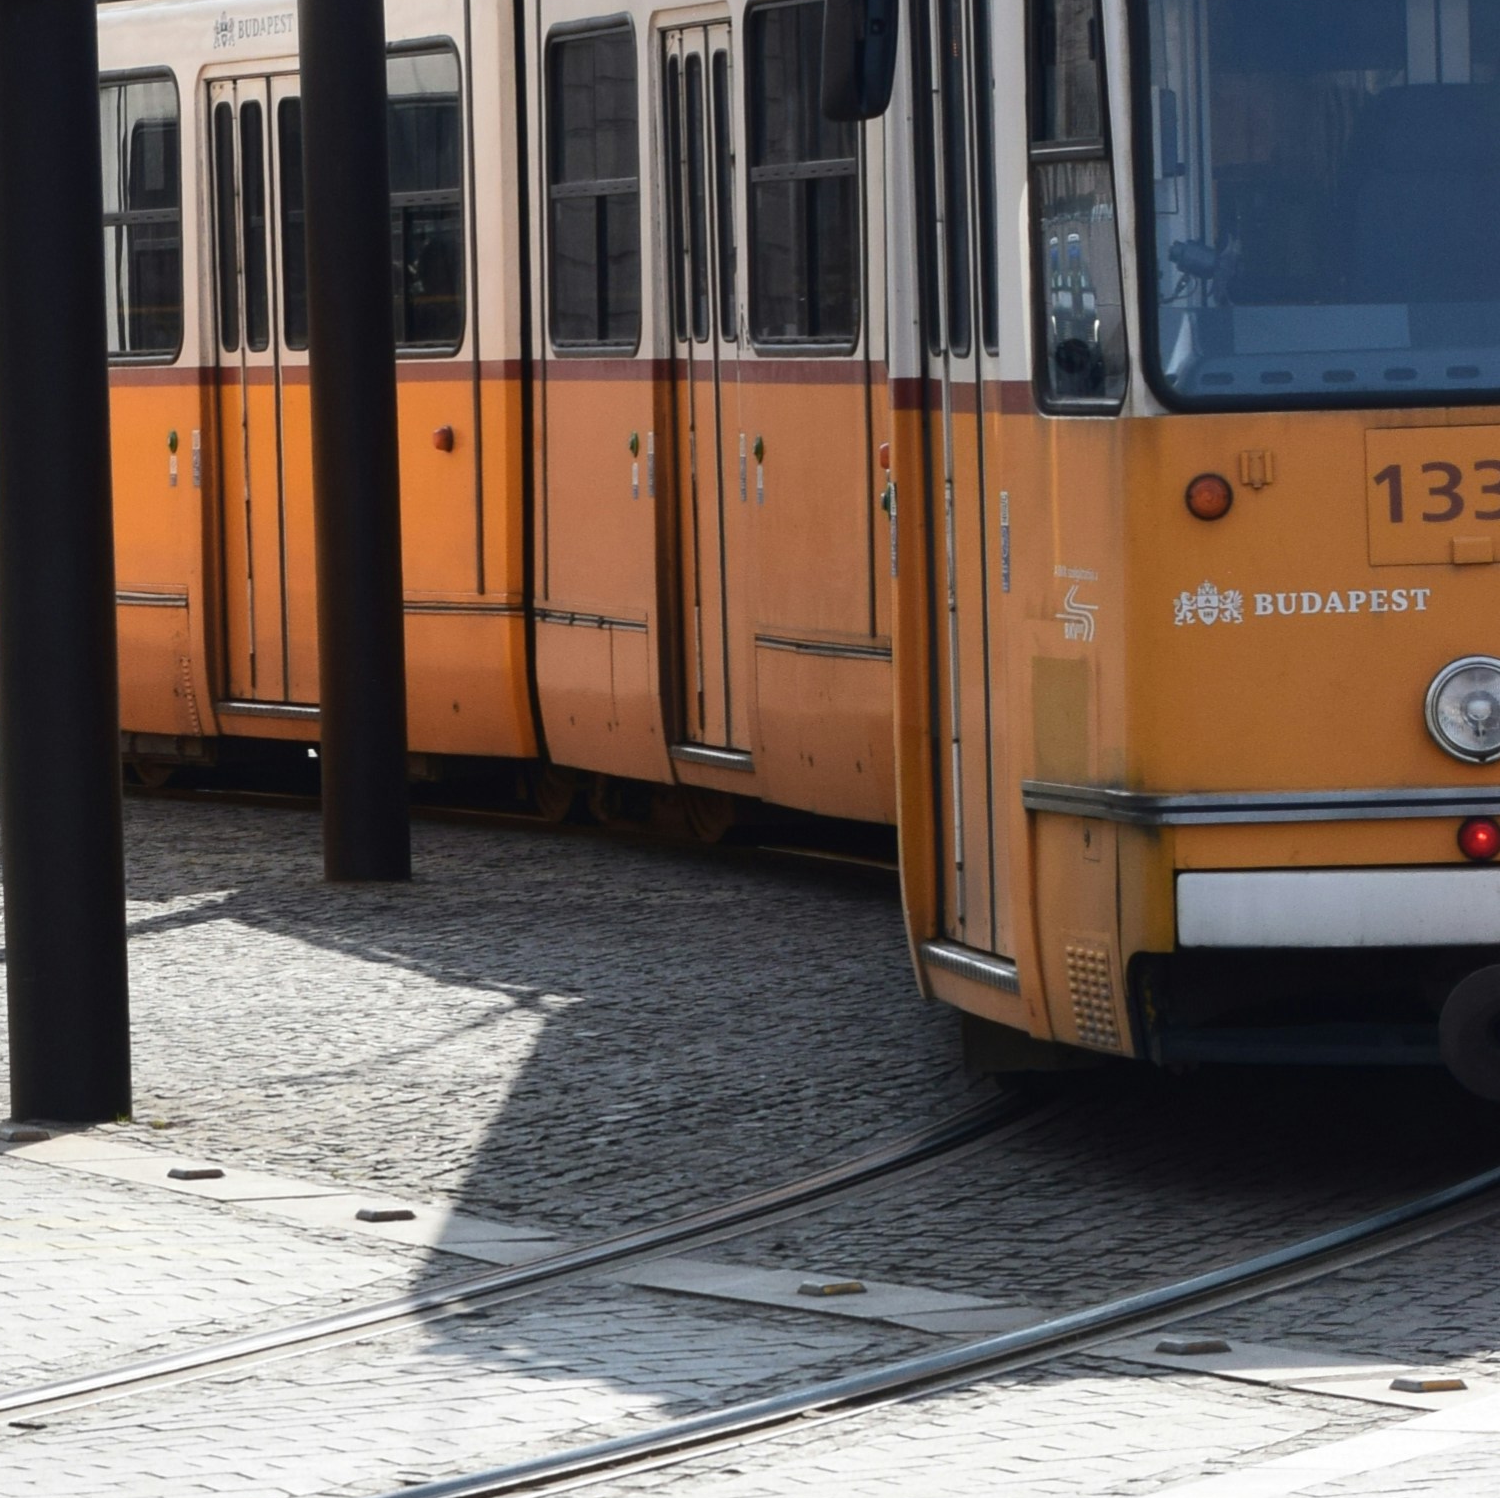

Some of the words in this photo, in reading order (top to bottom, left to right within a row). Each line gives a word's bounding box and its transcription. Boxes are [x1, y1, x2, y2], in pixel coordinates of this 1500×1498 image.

[238, 13, 294, 39] BUDAPEST
[1373, 459, 1500, 524] 133
[1253, 587, 1432, 616] BUDAPEST
